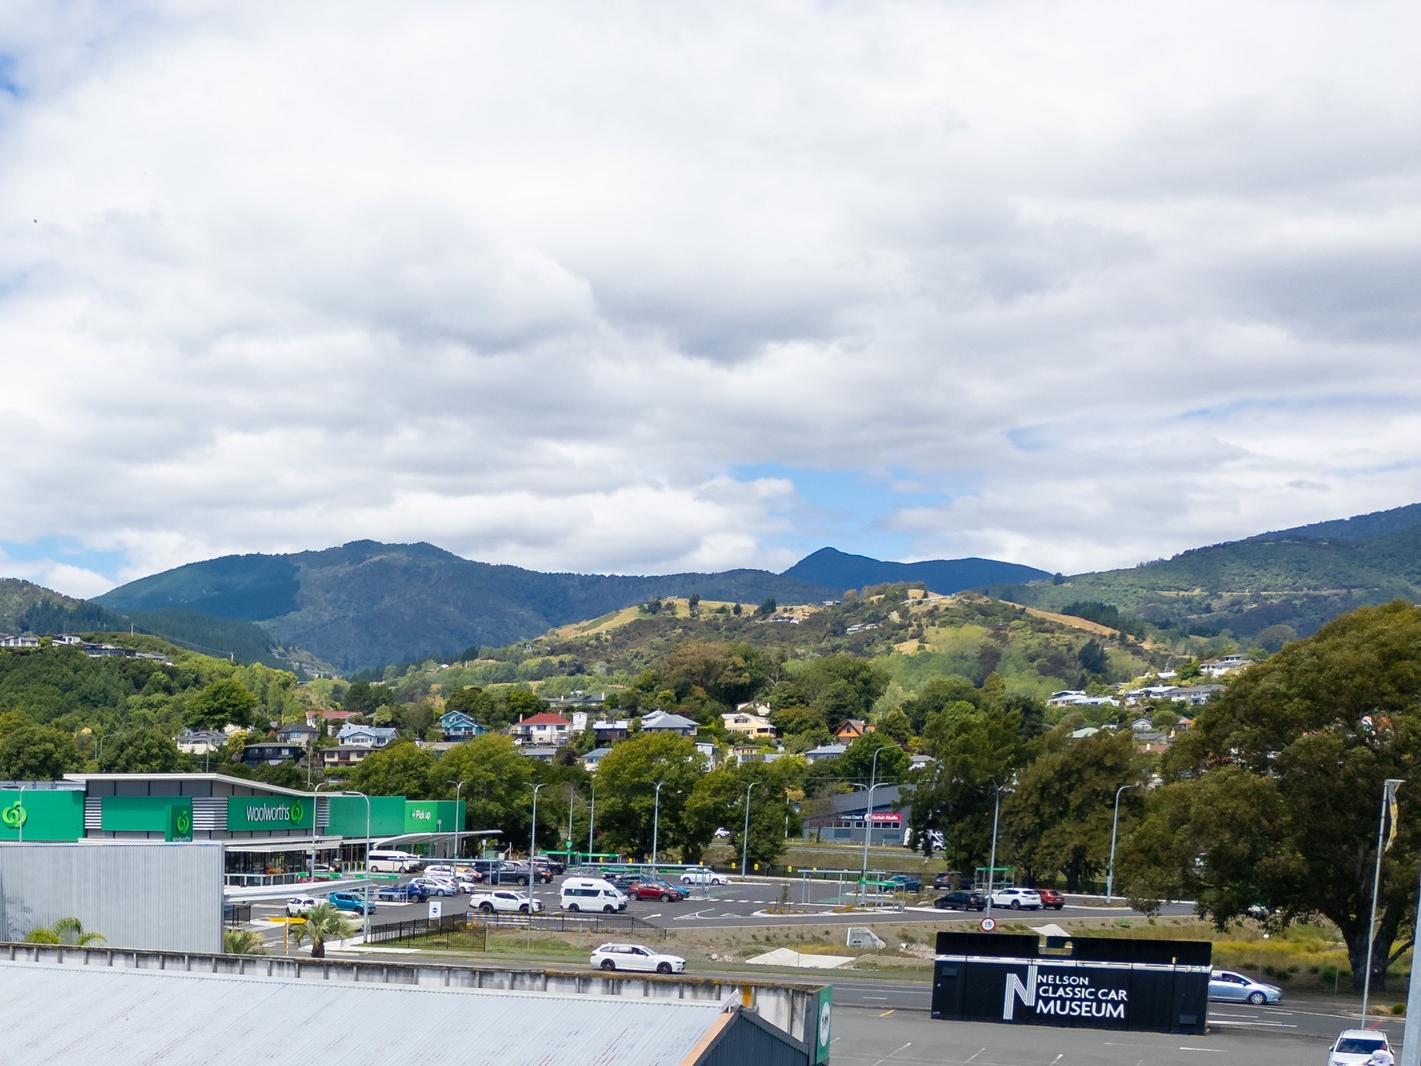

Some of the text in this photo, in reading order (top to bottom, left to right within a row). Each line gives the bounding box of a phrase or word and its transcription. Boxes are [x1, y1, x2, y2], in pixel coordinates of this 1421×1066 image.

[1037, 975, 1088, 986] NELSON
[1039, 986, 1128, 1001] CLASSIC CAR
[1036, 1000, 1125, 1018] MUSEUM
